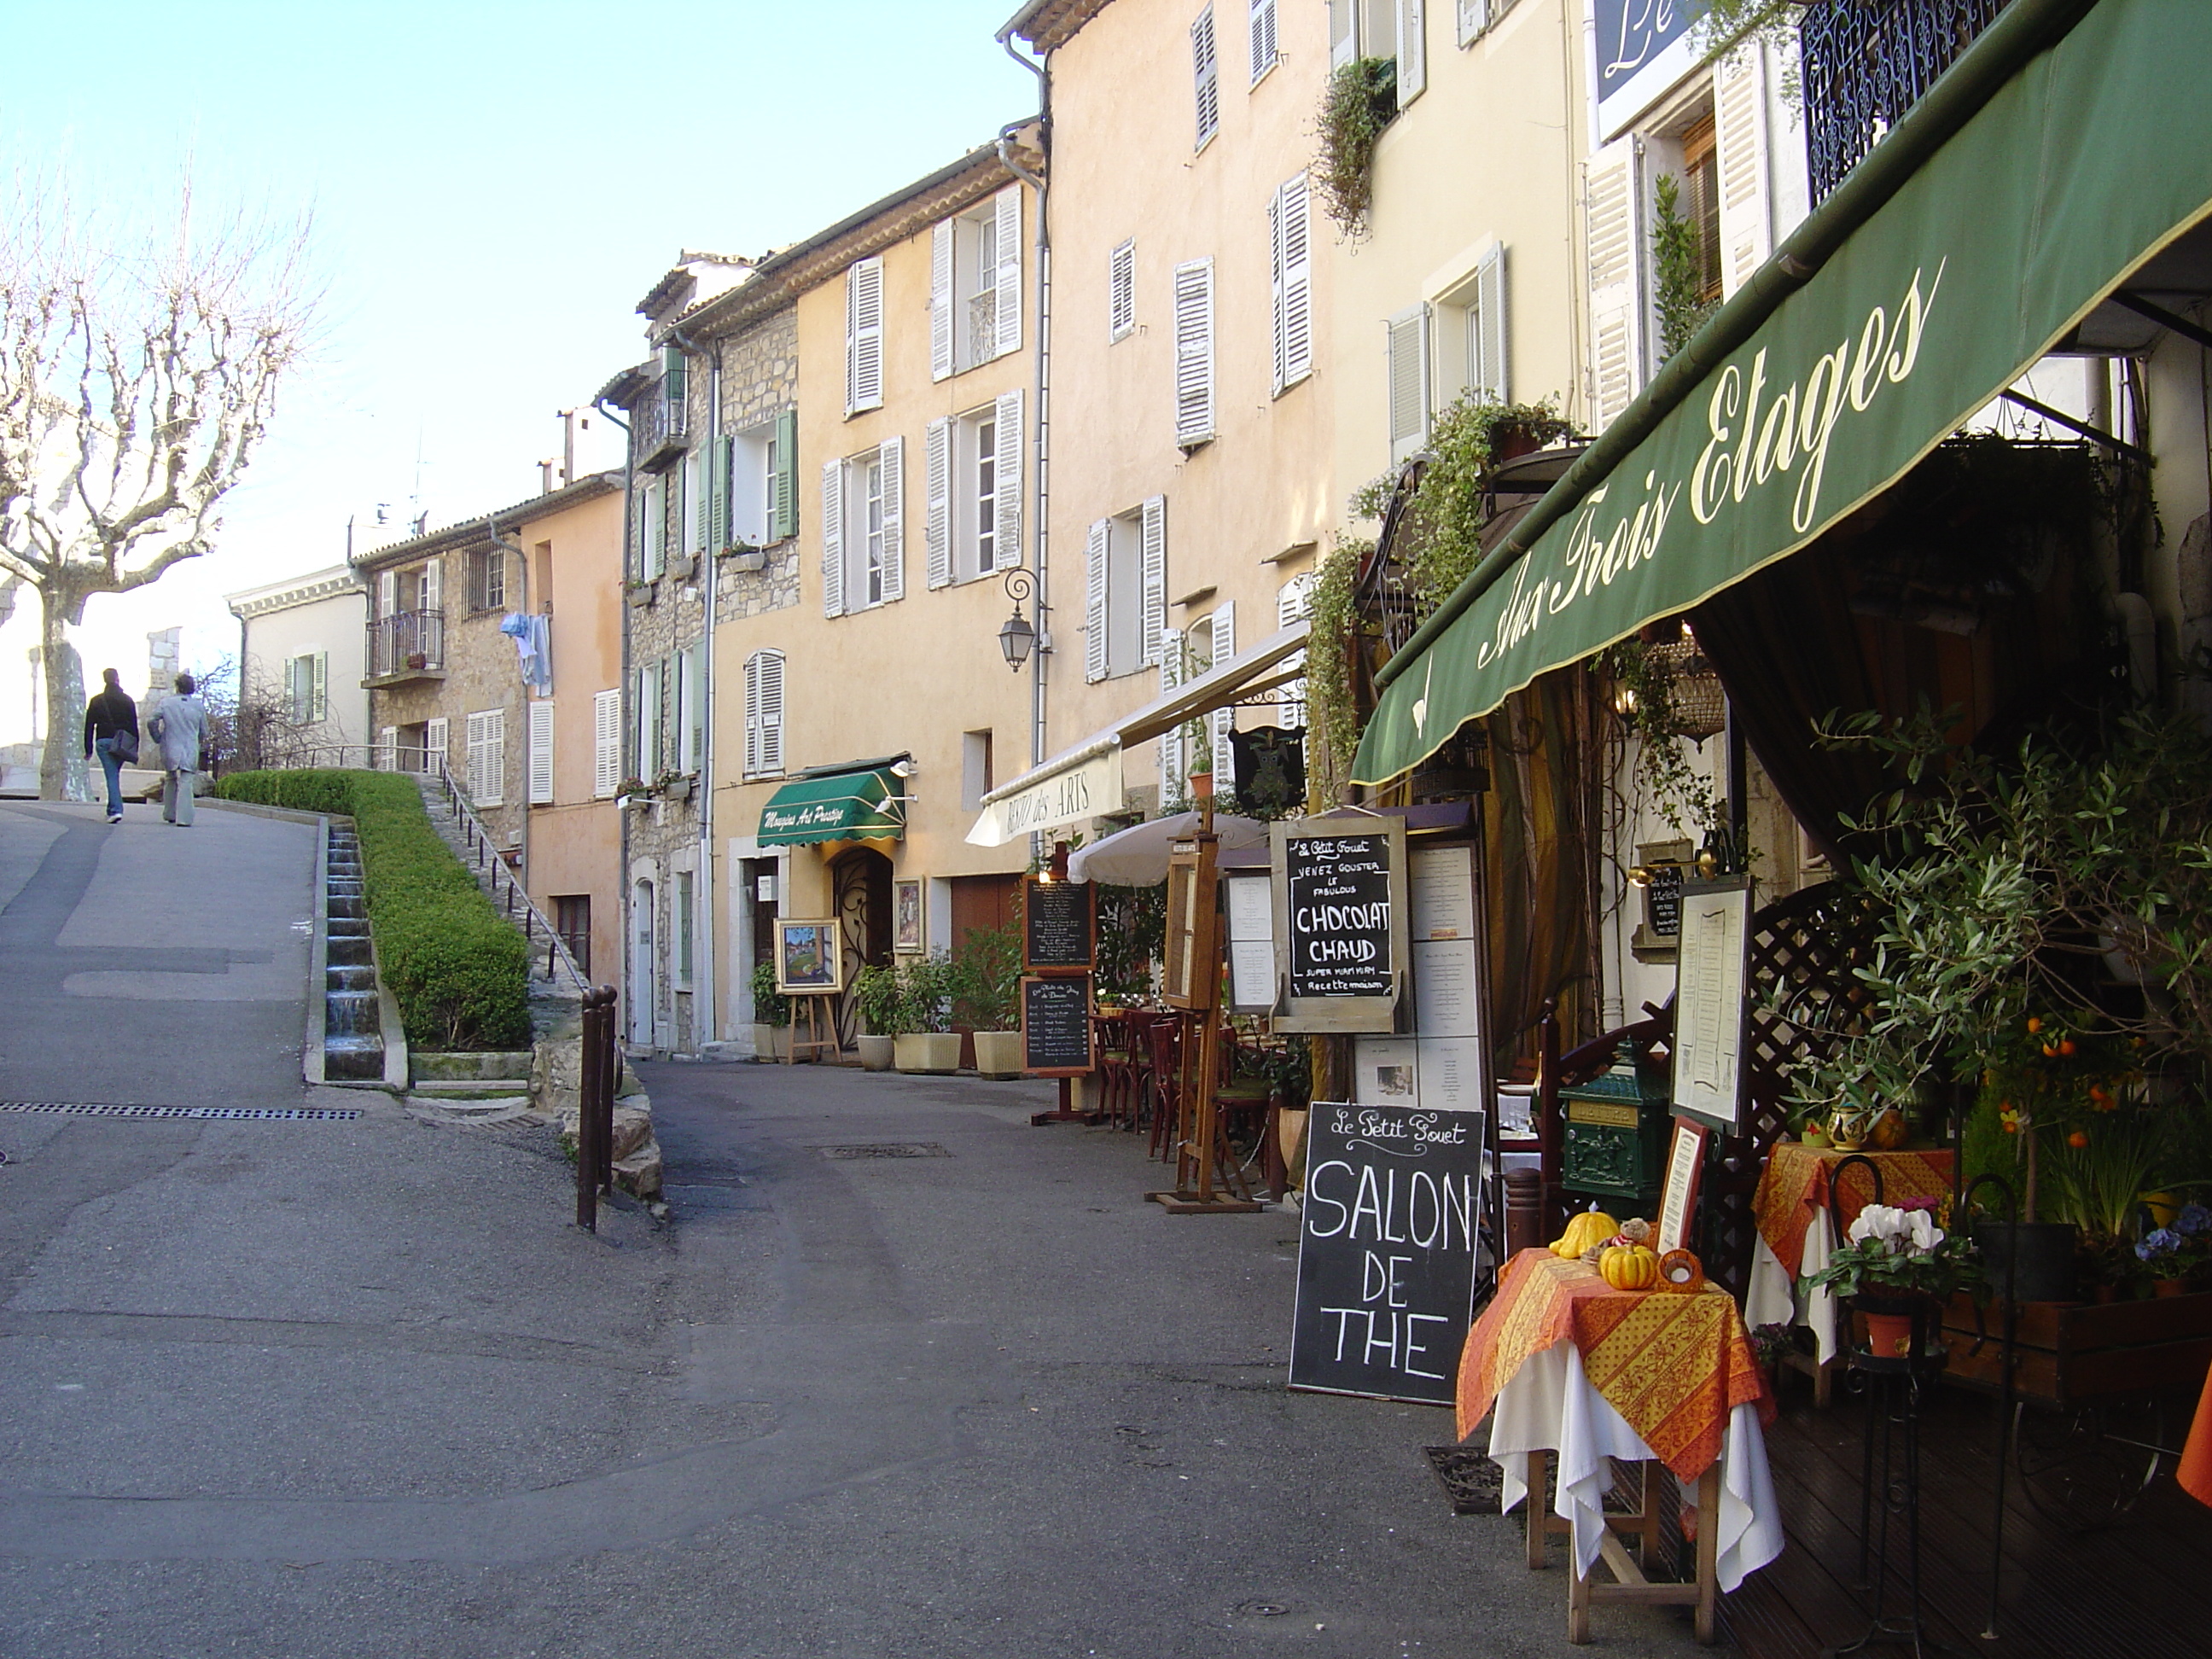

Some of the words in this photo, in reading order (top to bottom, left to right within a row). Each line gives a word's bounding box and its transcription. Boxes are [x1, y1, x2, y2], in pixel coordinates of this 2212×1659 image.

[1549, 469, 1682, 614] Trois
[1690, 255, 1947, 533] Etages
[1033, 789, 1050, 824] des
[1055, 771, 1090, 818] ARTS
[796, 807, 812, 827] Art
[813, 806, 844, 827] Prestige
[1311, 841, 1335, 854] Petit
[1298, 864, 1332, 877] VENEZ
[1338, 861, 1379, 872] GOUSTER
[1327, 876, 1338, 886] LE
[1313, 885, 1357, 897] FABULOUS
[1296, 902, 1389, 934] CHOCOLAT
[1309, 939, 1376, 963] CHAUD
[1306, 968, 1332, 977] SUPER
[1307, 979, 1348, 990] Recette
[1348, 980, 1383, 989] maison
[1330, 1109, 1355, 1135] Le
[1358, 1109, 1408, 1138] Petit
[1408, 1112, 1467, 1144] Fouet
[1309, 1161, 1471, 1252] SALON
[1362, 1250, 1412, 1308] DE
[1320, 1307, 1448, 1380] THE
